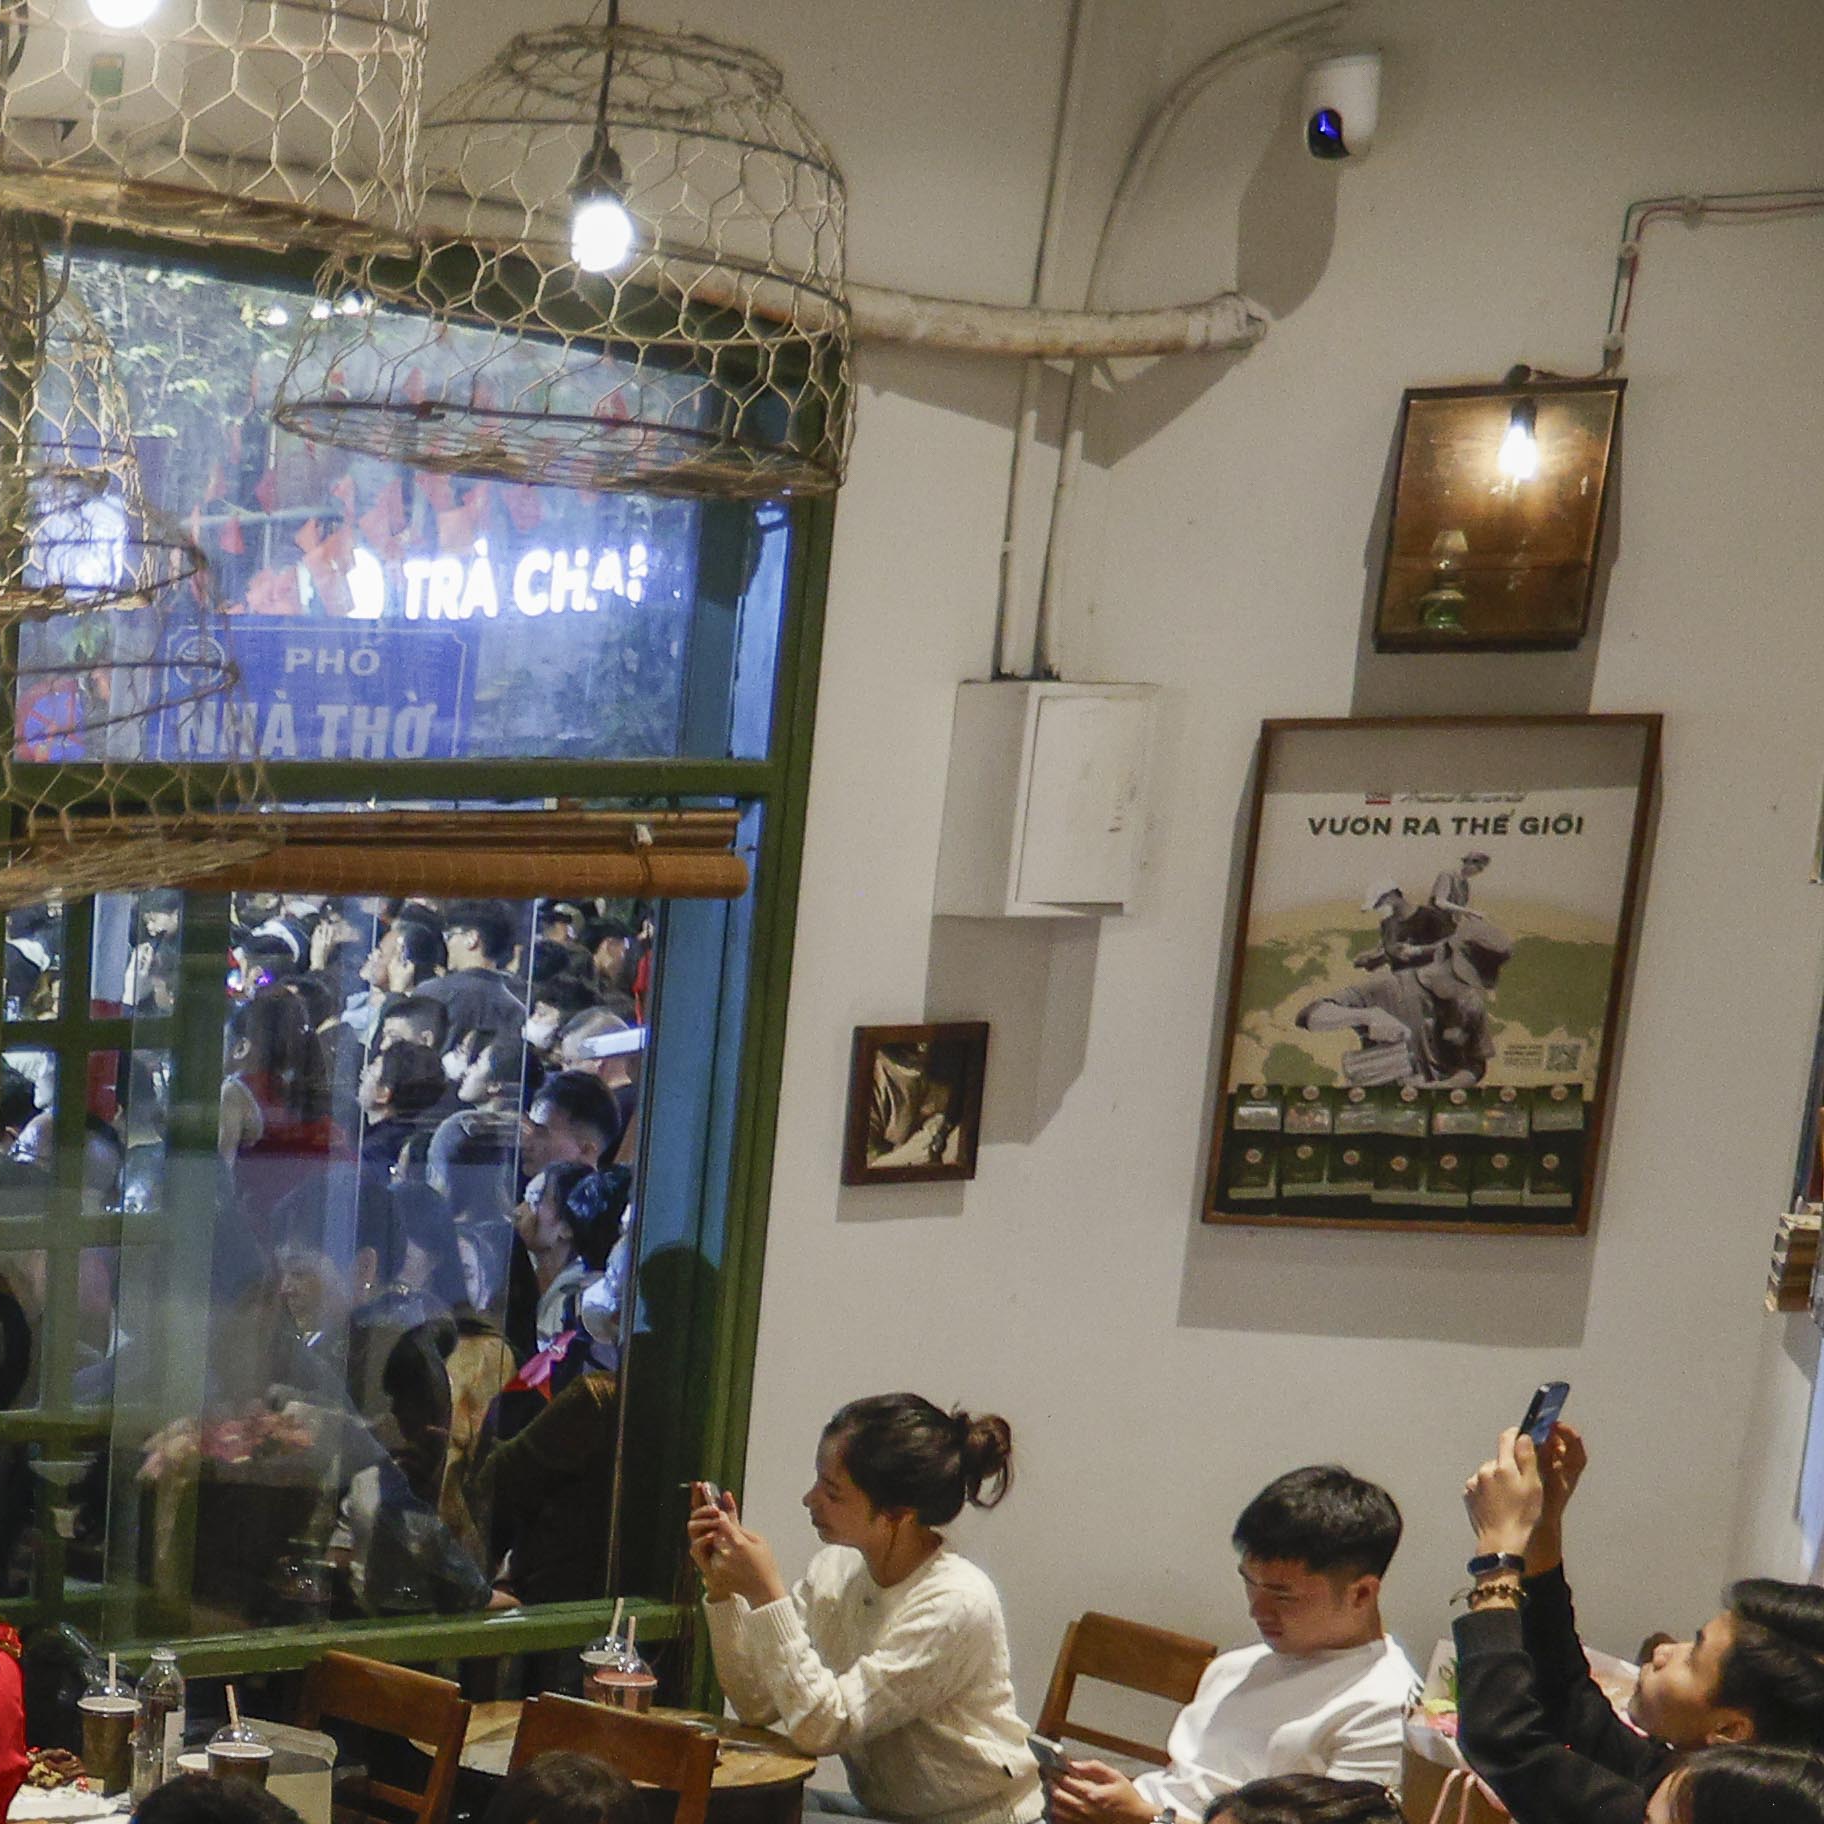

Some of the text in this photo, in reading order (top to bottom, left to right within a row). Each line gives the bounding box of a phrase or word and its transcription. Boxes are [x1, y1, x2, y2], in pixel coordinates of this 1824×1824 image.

[403, 538, 498, 619] TRÀ
[284, 620, 381, 676] PHỐ
[177, 687, 439, 758] NHÀ THỜ
[1308, 808, 1583, 837] VƯƠN RA THẾ GIỚI
